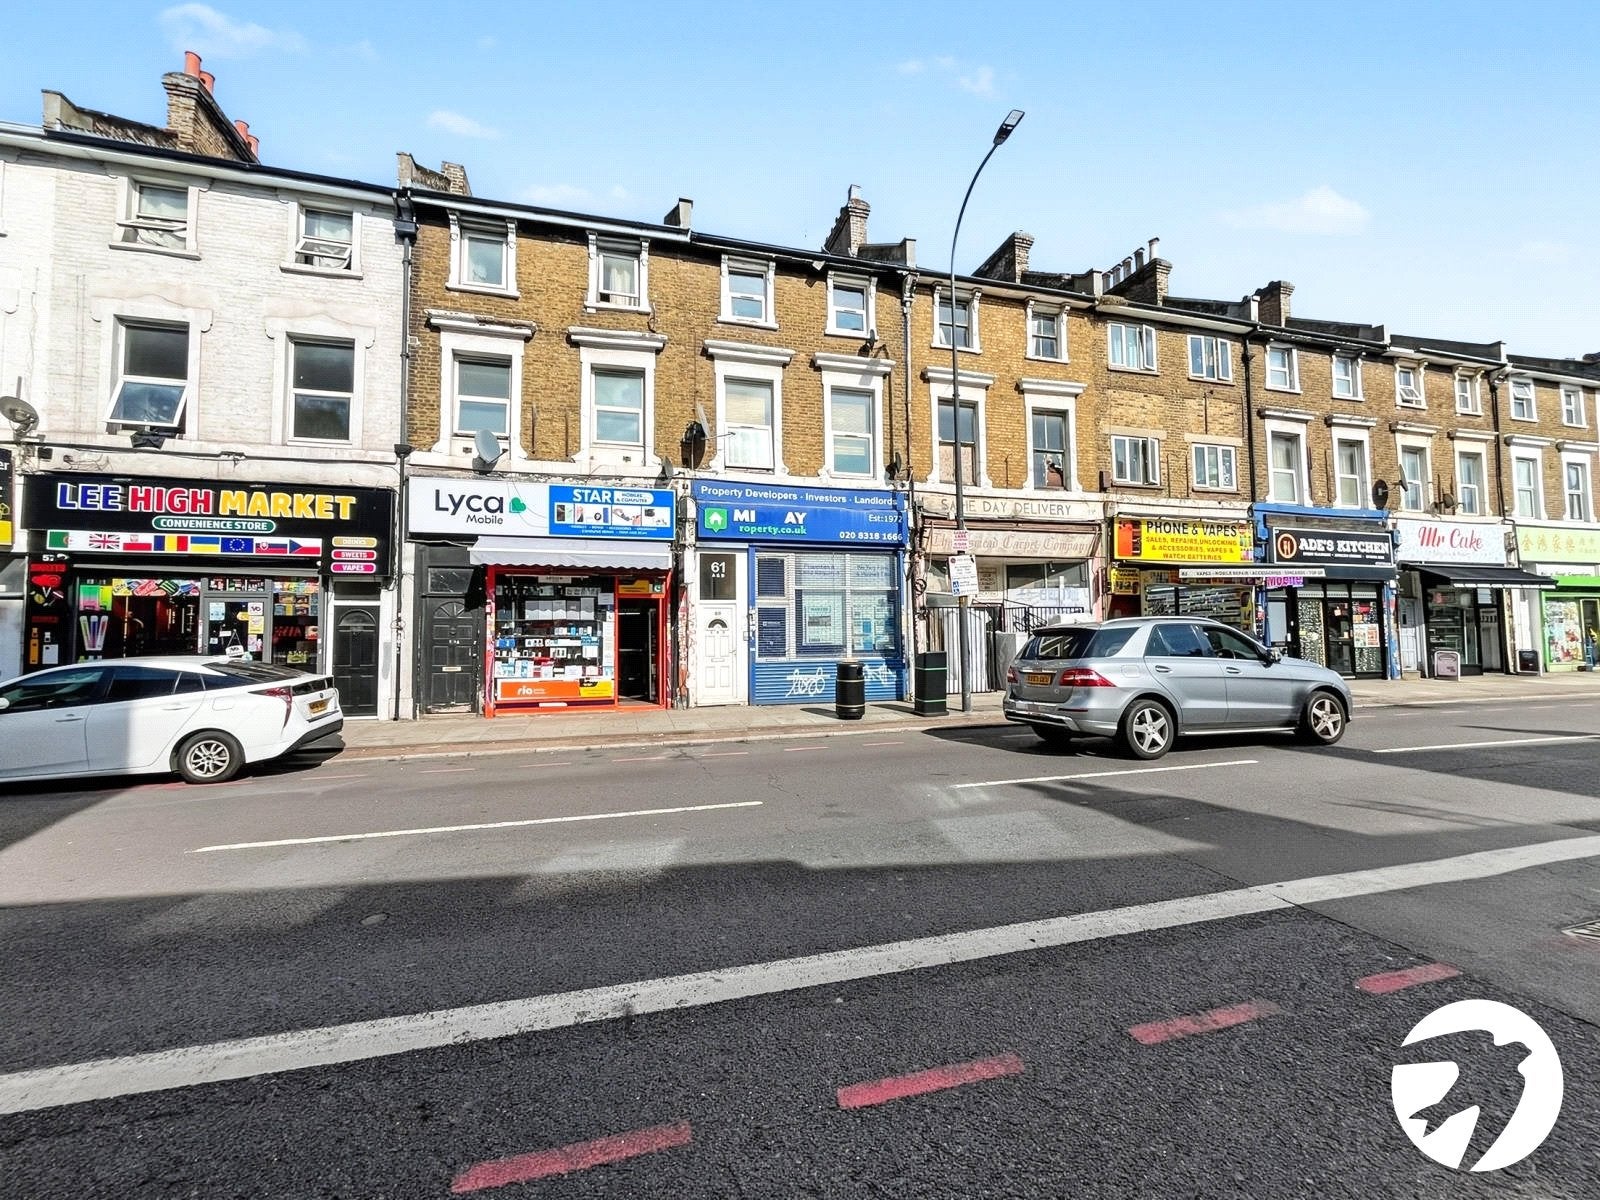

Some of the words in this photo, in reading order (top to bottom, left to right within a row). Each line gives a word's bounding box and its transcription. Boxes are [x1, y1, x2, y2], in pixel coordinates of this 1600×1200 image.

[56, 482, 122, 511] LEE
[128, 485, 213, 514] HIGH
[219, 490, 357, 520] MARKET
[435, 489, 504, 516] Lyca
[572, 489, 612, 504] STAR
[701, 485, 743, 498] Property
[745, 489, 798, 500] Developers
[805, 493, 847, 503] Investors
[854, 496, 898, 505] Landlords
[982, 501, 1008, 513] DAY
[1014, 502, 1072, 516] DELIVERY
[466, 514, 504, 524] Mobile
[733, 509, 756, 522] MI
[784, 511, 807, 524] AY
[160, 518, 232, 529] CONVENIENCE
[235, 521, 268, 531] STORE
[739, 525, 807, 535] roperty.co.uk
[1146, 520, 1188, 534] PHONE
[1191, 522, 1198, 535] &
[1202, 523, 1237, 537] VAPES
[839, 531, 856, 539] 020
[858, 532, 880, 540] 8318
[882, 532, 903, 541] 1666
[1418, 526, 1445, 548] Mr
[1450, 528, 1483, 552] Cake
[1001, 535, 1039, 553] Carpet
[1043, 536, 1091, 554] Company
[1299, 538, 1335, 552] ADE'S
[1336, 540, 1389, 554] KITCHEN
[711, 561, 726, 573] 61
